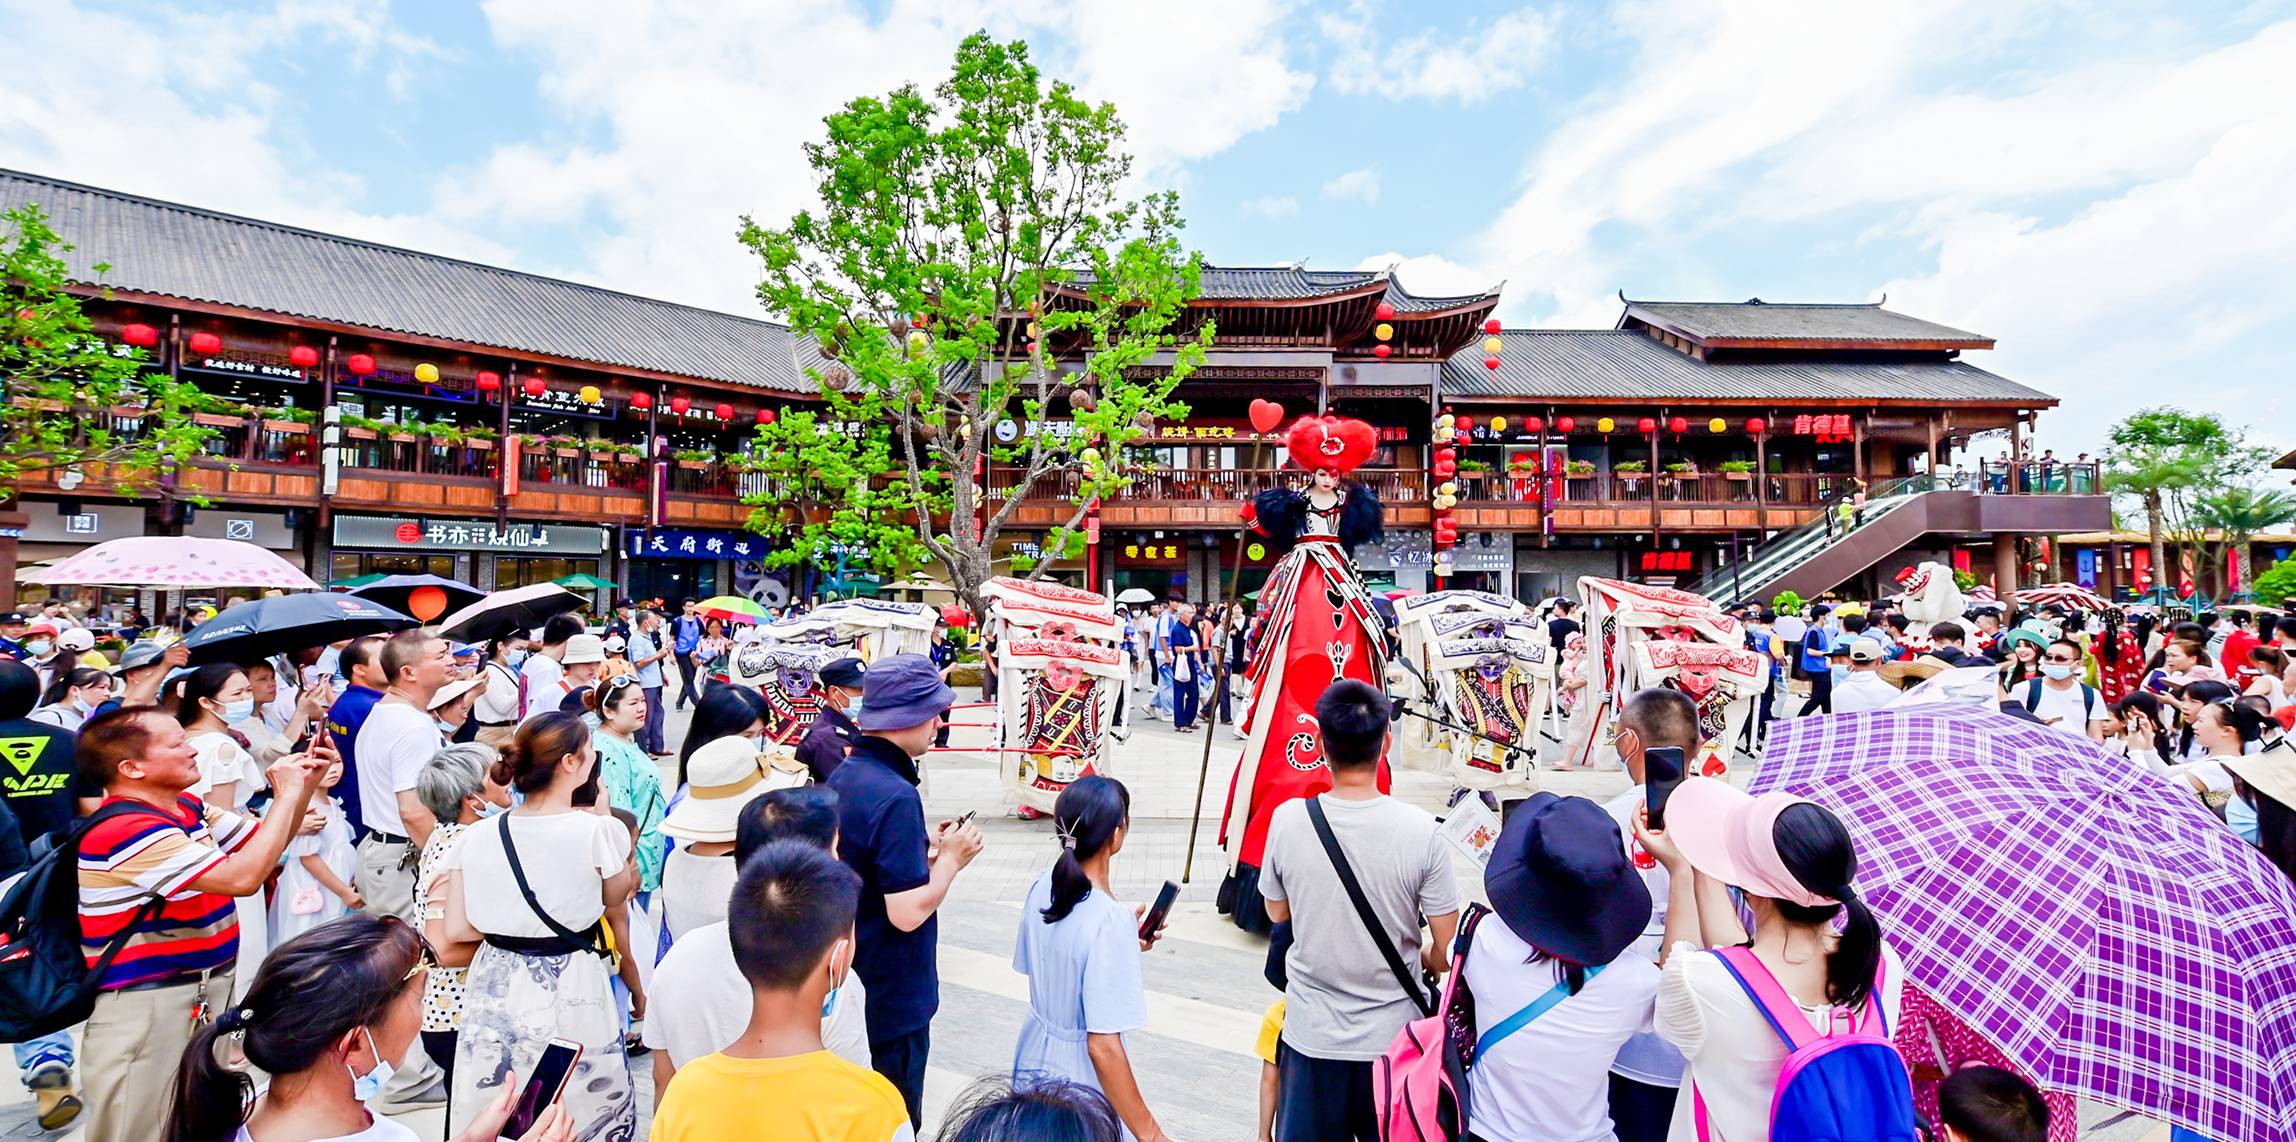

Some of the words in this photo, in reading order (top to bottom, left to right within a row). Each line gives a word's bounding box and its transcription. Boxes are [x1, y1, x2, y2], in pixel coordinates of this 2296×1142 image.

[1794, 413, 1851, 435] 肯德基
[2020, 438, 2030, 451] K
[1011, 542, 1040, 551] TIME
[1024, 550, 1068, 560] TRAEL
[1642, 551, 1693, 570] 肯德基
